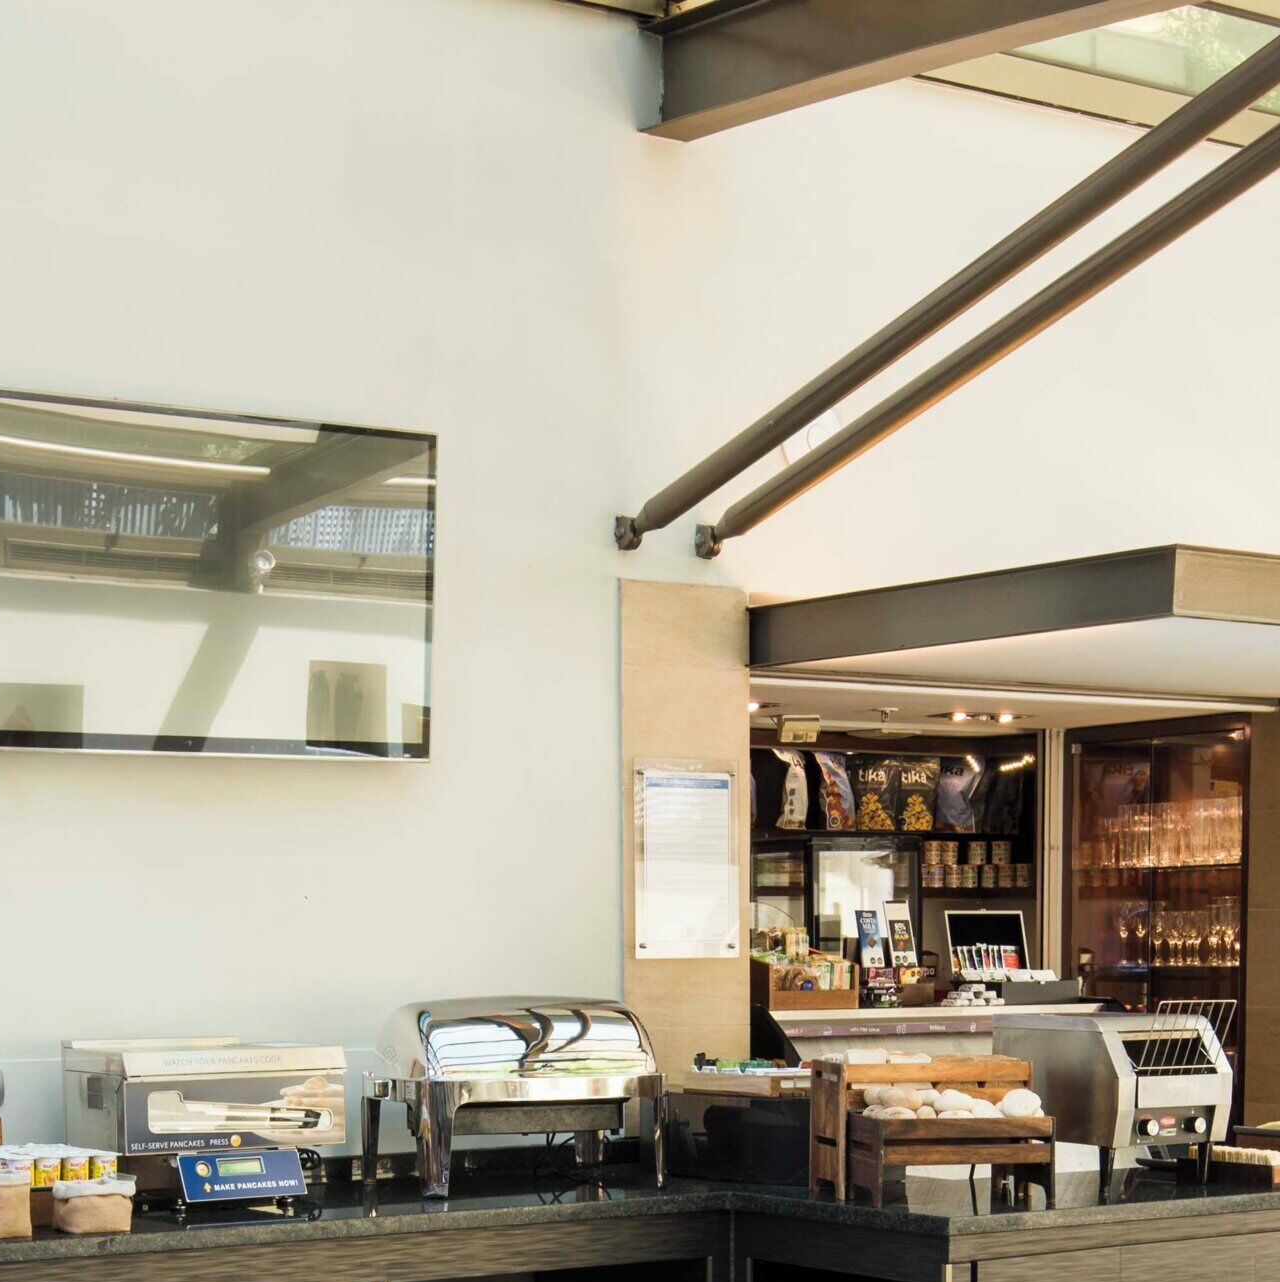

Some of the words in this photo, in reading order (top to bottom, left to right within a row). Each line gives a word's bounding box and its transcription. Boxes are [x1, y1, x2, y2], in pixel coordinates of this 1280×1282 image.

[858, 769, 886, 782] tika
[901, 770, 927, 784] tika
[163, 1056, 193, 1067] WATCH
[130, 1141, 168, 1151] SELF-SERVE
[170, 1139, 205, 1148] PANCAKES
[209, 1138, 229, 1146] PRESS
[214, 1183, 236, 1191] MAKE
[237, 1181, 277, 1189] PANCAKES
[278, 1179, 298, 1187] NOW!
